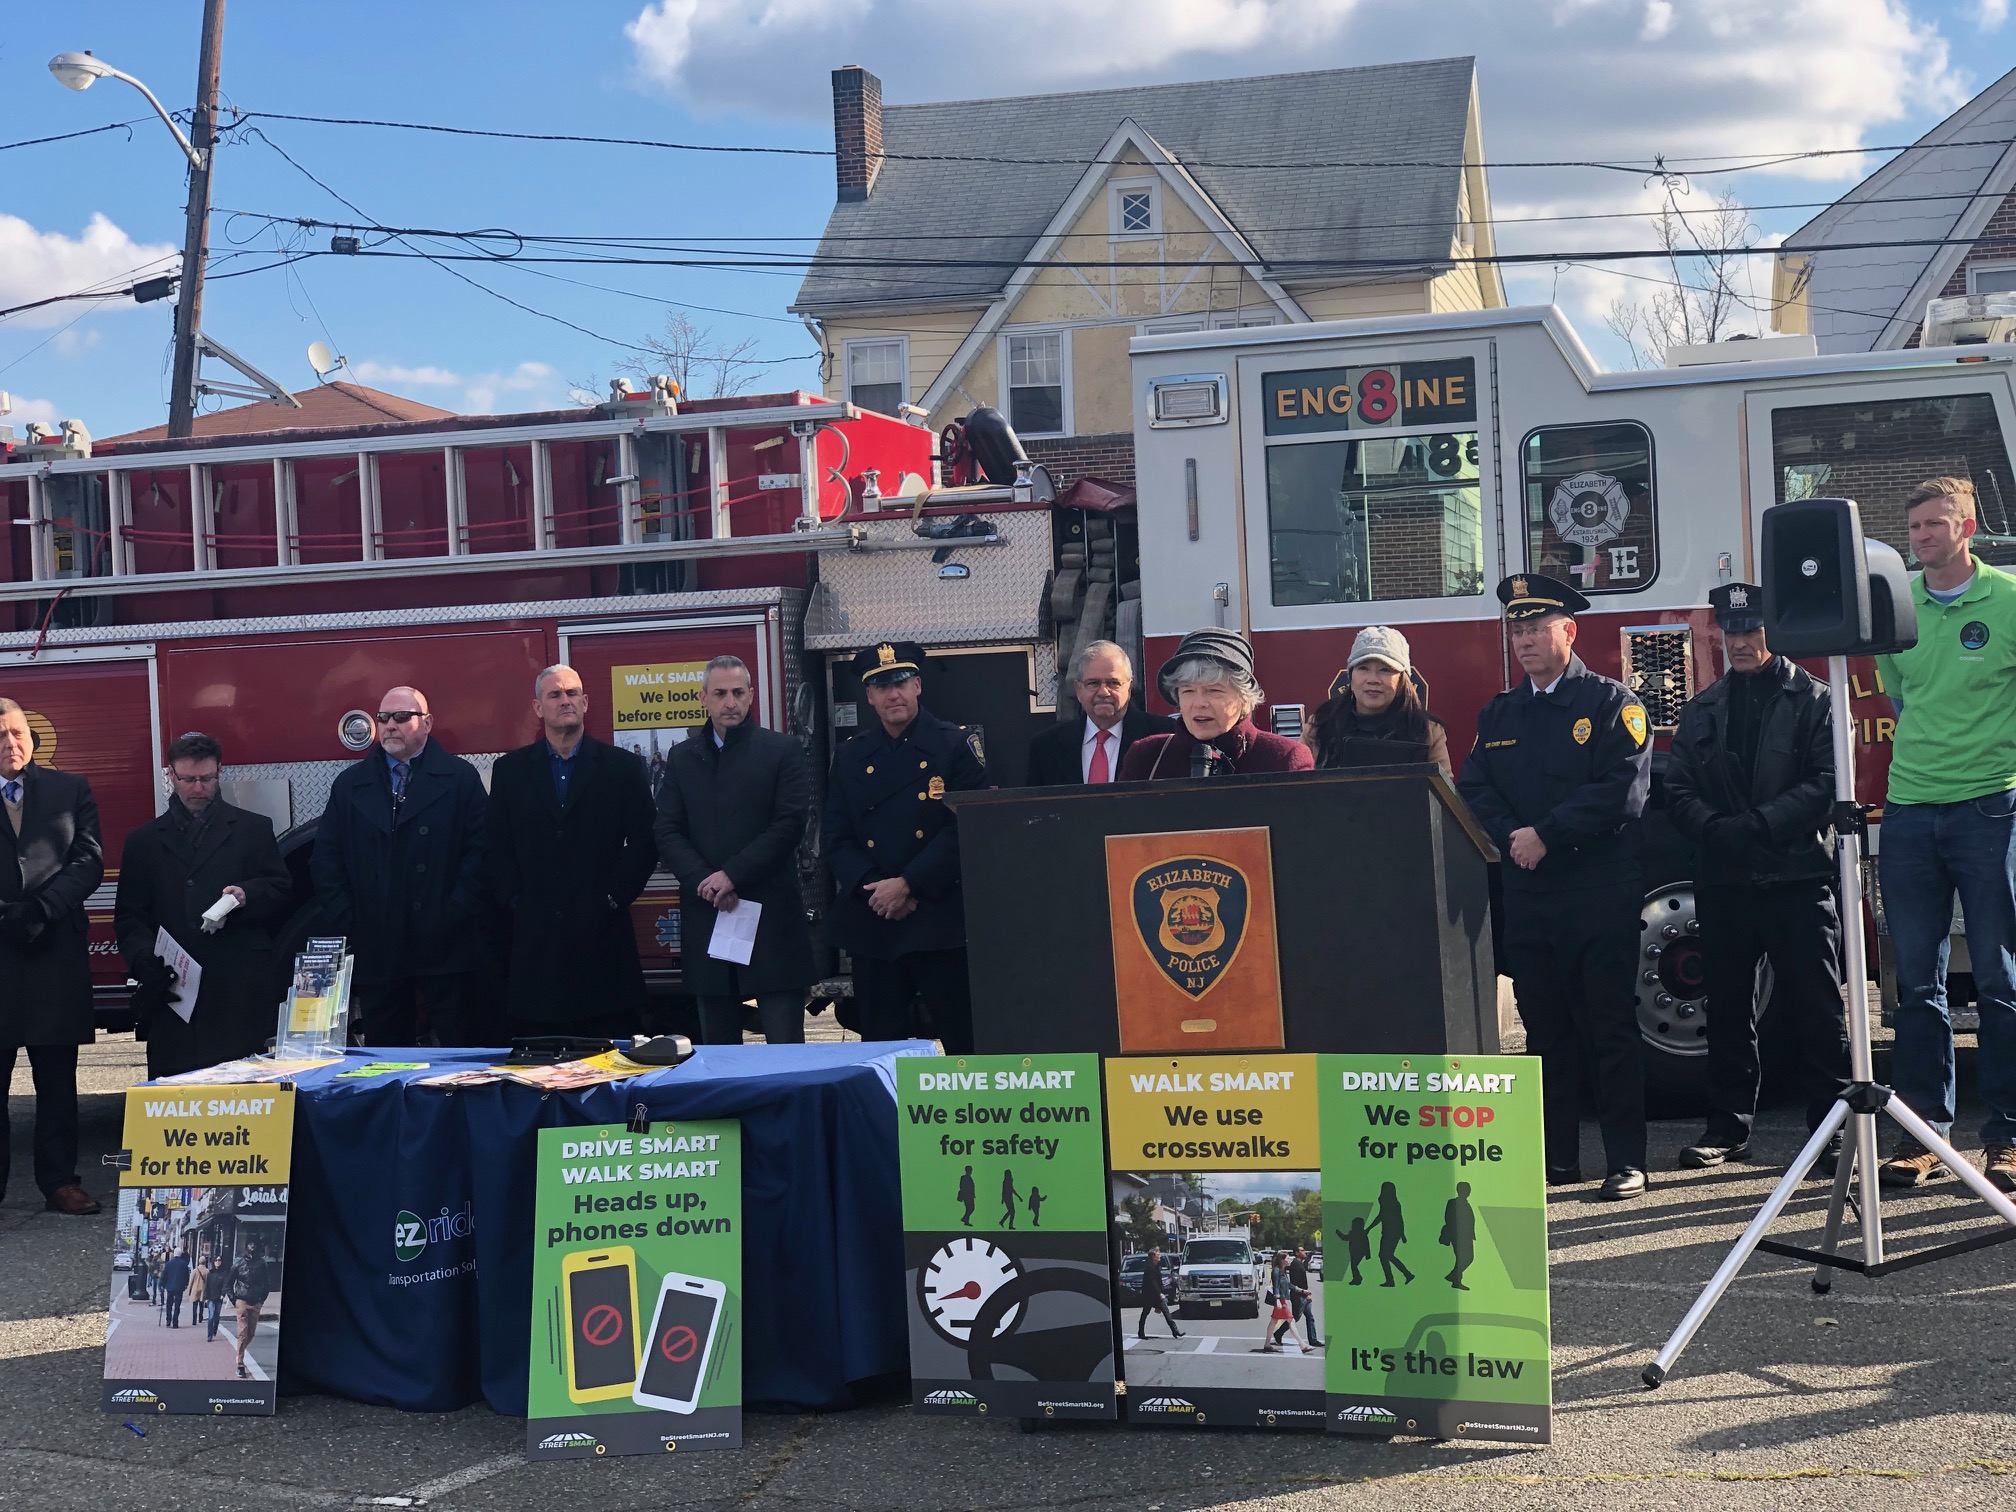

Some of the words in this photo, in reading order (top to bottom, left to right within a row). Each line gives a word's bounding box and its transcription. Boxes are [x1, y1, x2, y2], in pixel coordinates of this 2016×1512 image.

[1570, 479, 1607, 489] ELIZABETH
[1573, 528, 1608, 536] ESTABLISHED
[1582, 535, 1600, 544] 1924
[1608, 546, 1640, 580] E
[624, 673, 665, 686] WALK
[668, 671, 704, 684] SMAR
[640, 691, 664, 704] We
[668, 689, 700, 703] look
[617, 709, 662, 723] before
[665, 706, 711, 721] crossi
[1146, 868, 1232, 892] ELIZABETH
[1167, 954, 1220, 973] POLICE
[1187, 977, 1205, 989] NJ
[919, 1072, 989, 1091] DRIVE
[994, 1070, 1076, 1090] SMART
[1130, 1073, 1204, 1093] WALK
[1209, 1071, 1294, 1092] SMART
[1342, 1071, 1420, 1093] DRIVE
[1426, 1073, 1516, 1094] SMART
[144, 1100, 203, 1118] WALK
[207, 1098, 275, 1117] SMART
[907, 1104, 948, 1124] We
[955, 1102, 1013, 1124] slow
[1019, 1101, 1090, 1123] down
[1164, 1105, 1208, 1127] We
[1216, 1108, 1263, 1126] use
[1364, 1104, 1411, 1127] We
[1418, 1105, 1495, 1128] STOP
[163, 1129, 198, 1147] We
[204, 1125, 251, 1147] wait
[562, 1138, 633, 1159] DRIVE
[639, 1134, 720, 1153] SMART
[939, 1134, 975, 1156] for
[982, 1133, 1060, 1160] safety
[1142, 1135, 1290, 1159] crosswalks
[1357, 1135, 1398, 1159] for
[1406, 1138, 1503, 1167] people
[140, 1157, 170, 1176] for
[176, 1157, 211, 1175] the
[218, 1155, 269, 1175] walk
[561, 1164, 634, 1185] WALK
[638, 1160, 720, 1181] SMART
[574, 1190, 657, 1214] Heads
[665, 1191, 707, 1213] up,
[548, 1221, 648, 1248] phones
[656, 1216, 731, 1237] down
[388, 1266, 460, 1287] Transportation
[1351, 1347, 1396, 1372] It's
[1404, 1350, 1458, 1376] the
[1468, 1352, 1524, 1379] law
[208, 1398, 265, 1406] BeStreetSmartNJ.org
[1037, 1400, 1105, 1410] BeStreetSmartNJ.org
[660, 1432, 730, 1442] BeStreetSmartNJ.org
[1464, 1421, 1539, 1433] BeStreetSmartNJ.org
